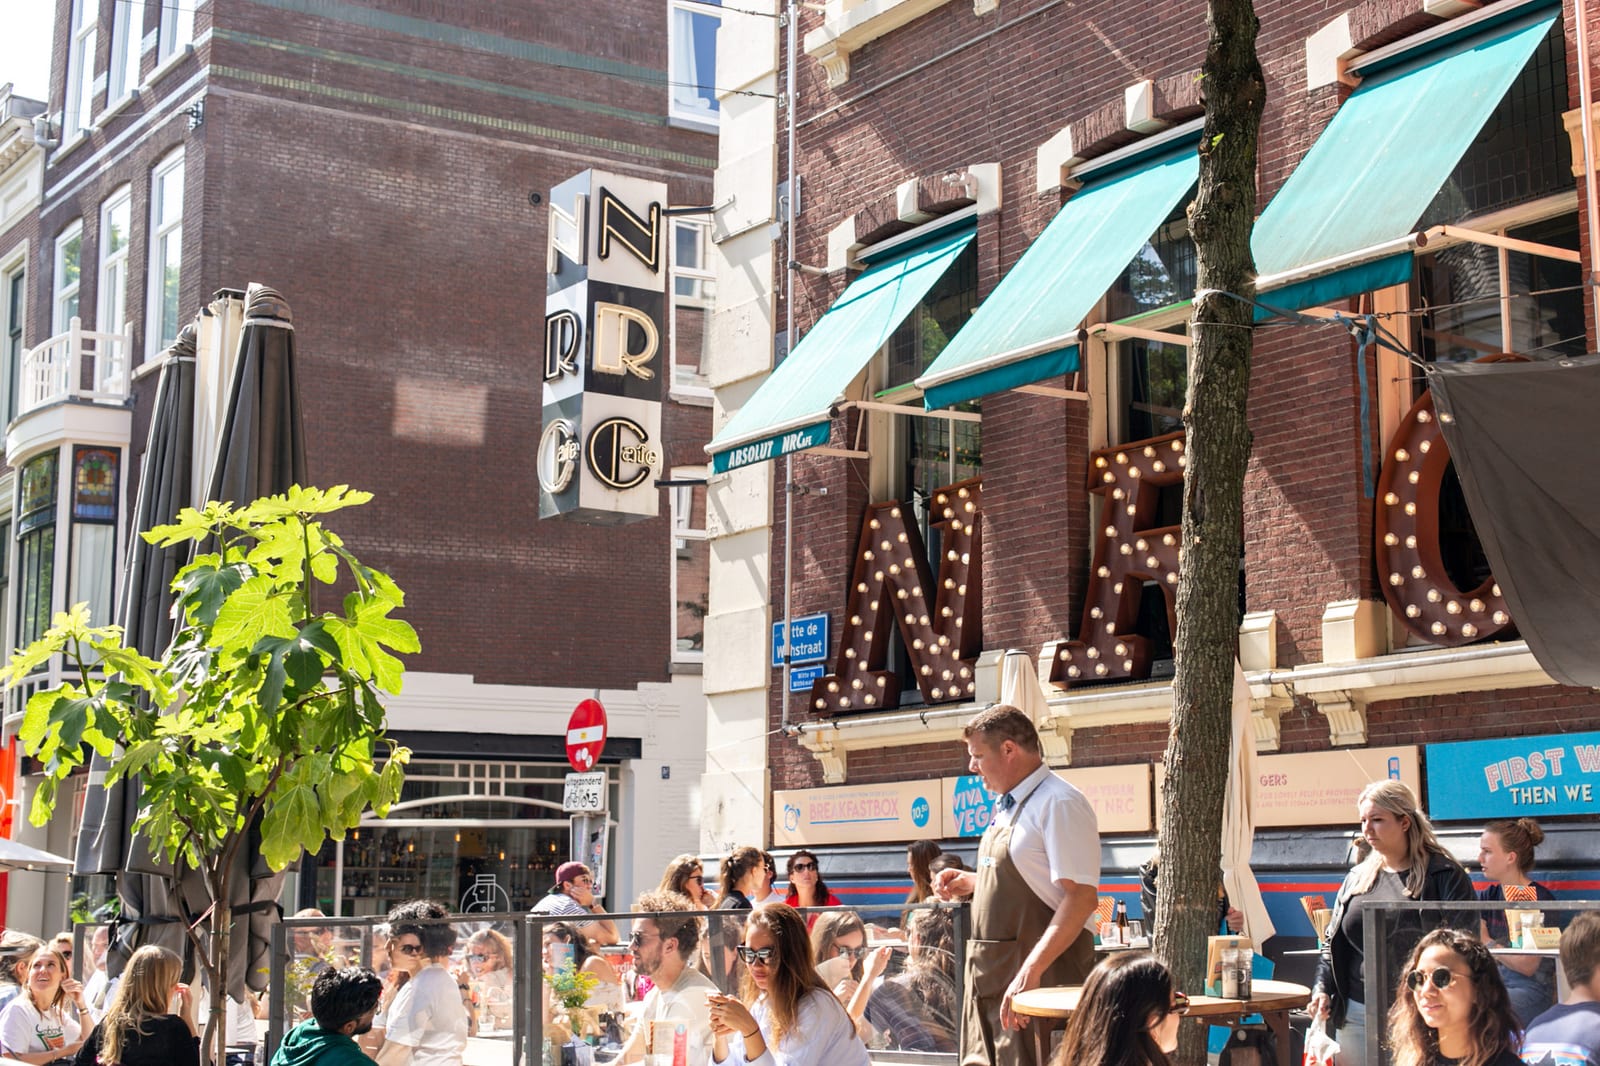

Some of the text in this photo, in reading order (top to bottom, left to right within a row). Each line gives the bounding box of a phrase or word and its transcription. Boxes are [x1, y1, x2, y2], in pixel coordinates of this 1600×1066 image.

[727, 440, 774, 469] ABSOLUT
[782, 622, 818, 638] tte de
[777, 640, 823, 659] Whstraat
[1484, 747, 1565, 793] FIRST
[953, 788, 984, 810] VIVA
[1509, 784, 1593, 805] THEN WE
[809, 798, 899, 821] BREAKFASTBOX
